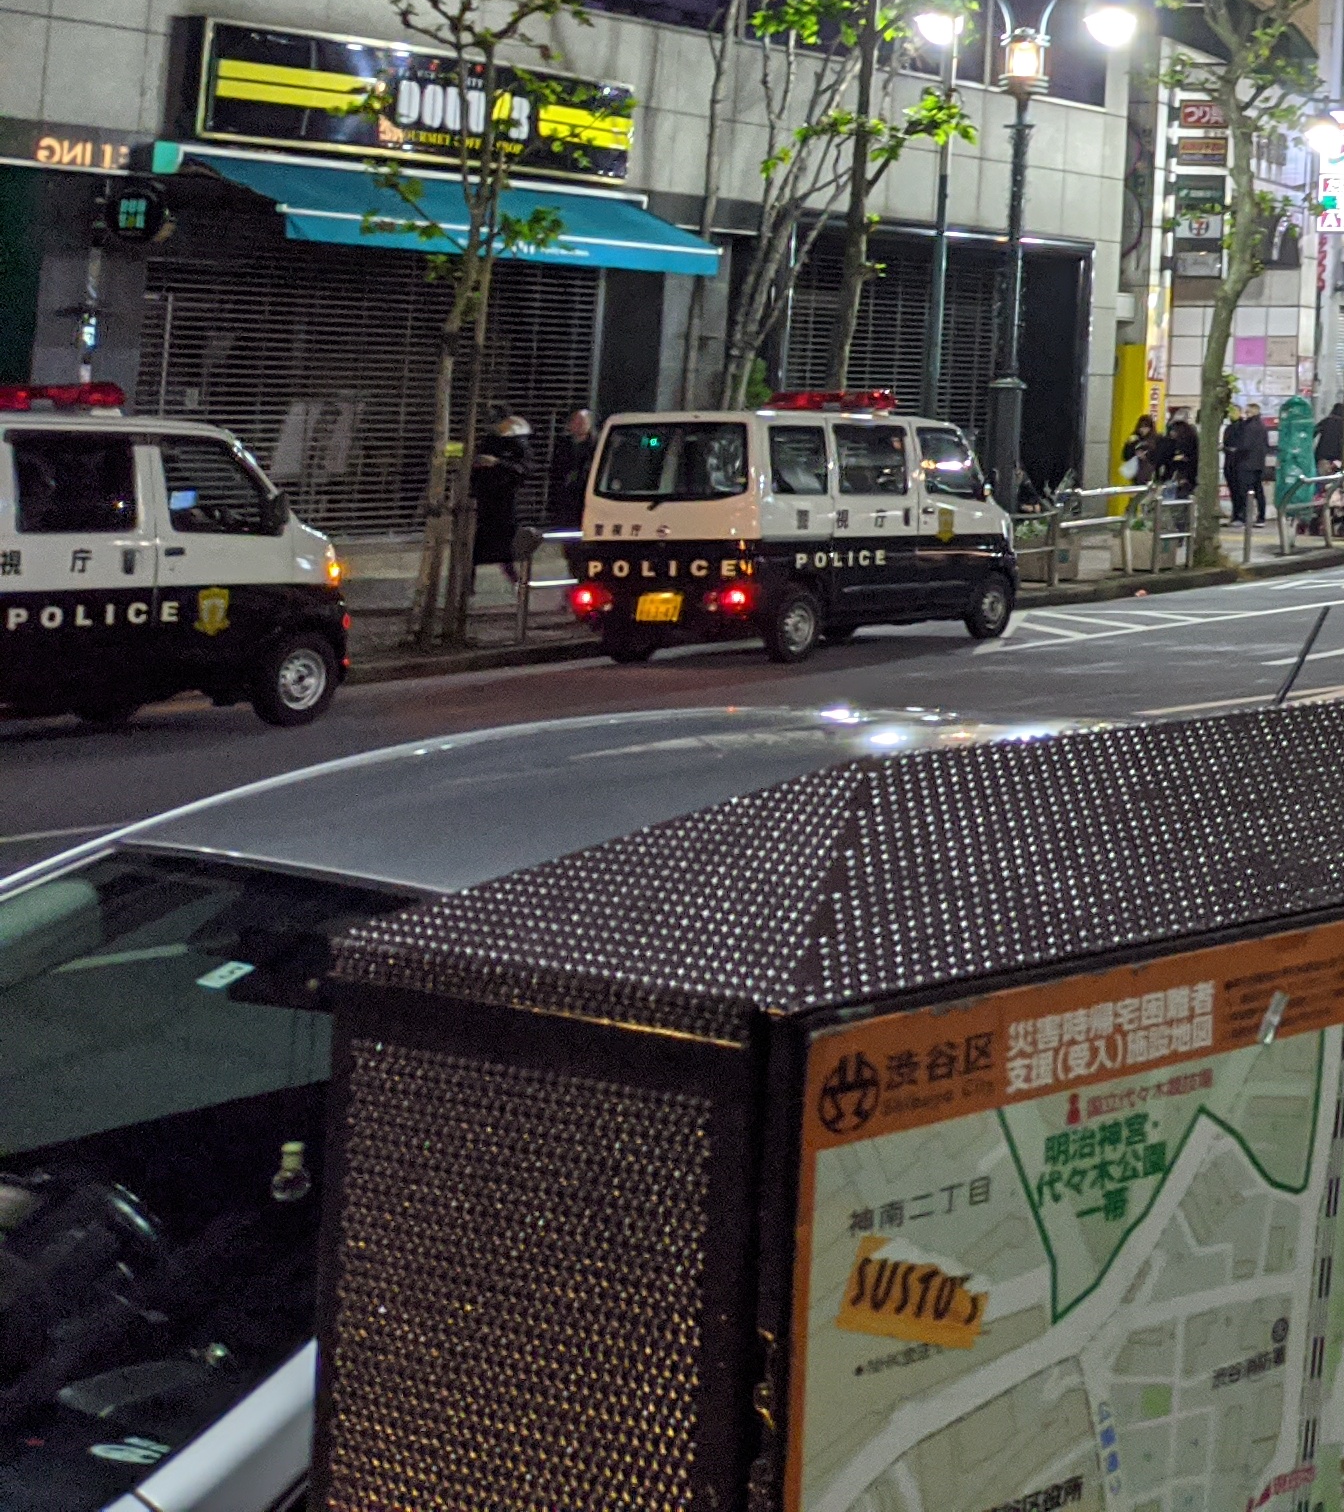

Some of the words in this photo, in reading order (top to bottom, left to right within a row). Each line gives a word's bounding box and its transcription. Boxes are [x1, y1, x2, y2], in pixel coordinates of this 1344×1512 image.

[588, 559, 737, 579] POLICE
[795, 549, 887, 570] POLICE
[6, 601, 181, 632] POLICE
[885, 1031, 995, 1090] 渋谷区
